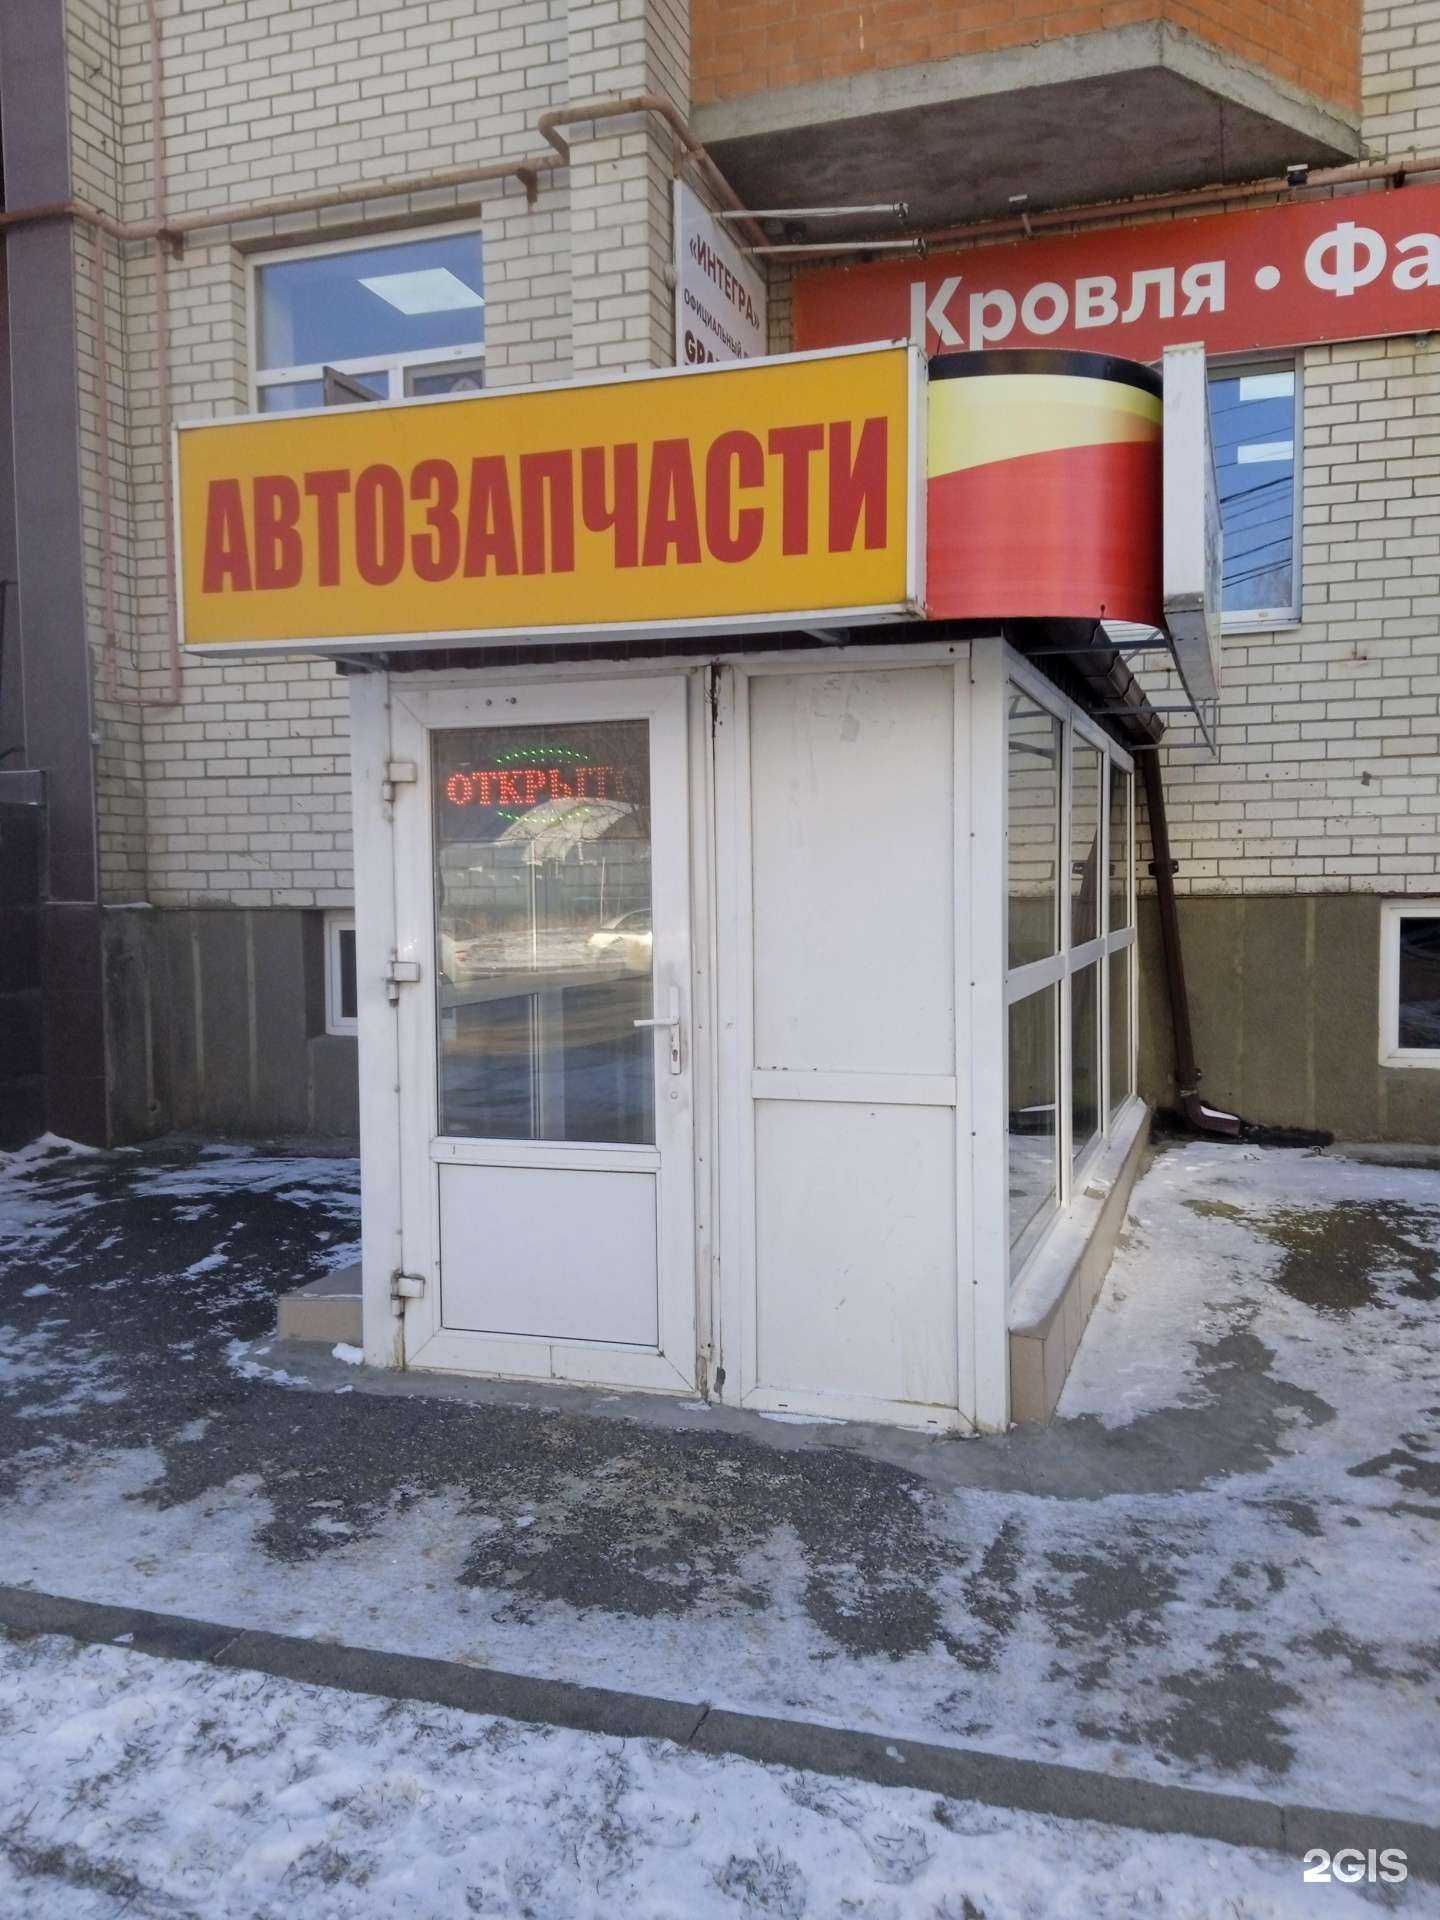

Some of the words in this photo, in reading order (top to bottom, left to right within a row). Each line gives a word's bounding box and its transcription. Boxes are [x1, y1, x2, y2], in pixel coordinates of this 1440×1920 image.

[690, 233, 760, 330] «ИНТЕГРА»
[911, 260, 1225, 350] Кровля
[1304, 221, 1440, 297] Фа
[201, 416, 888, 593] АВТОЗАПЧАСТИ
